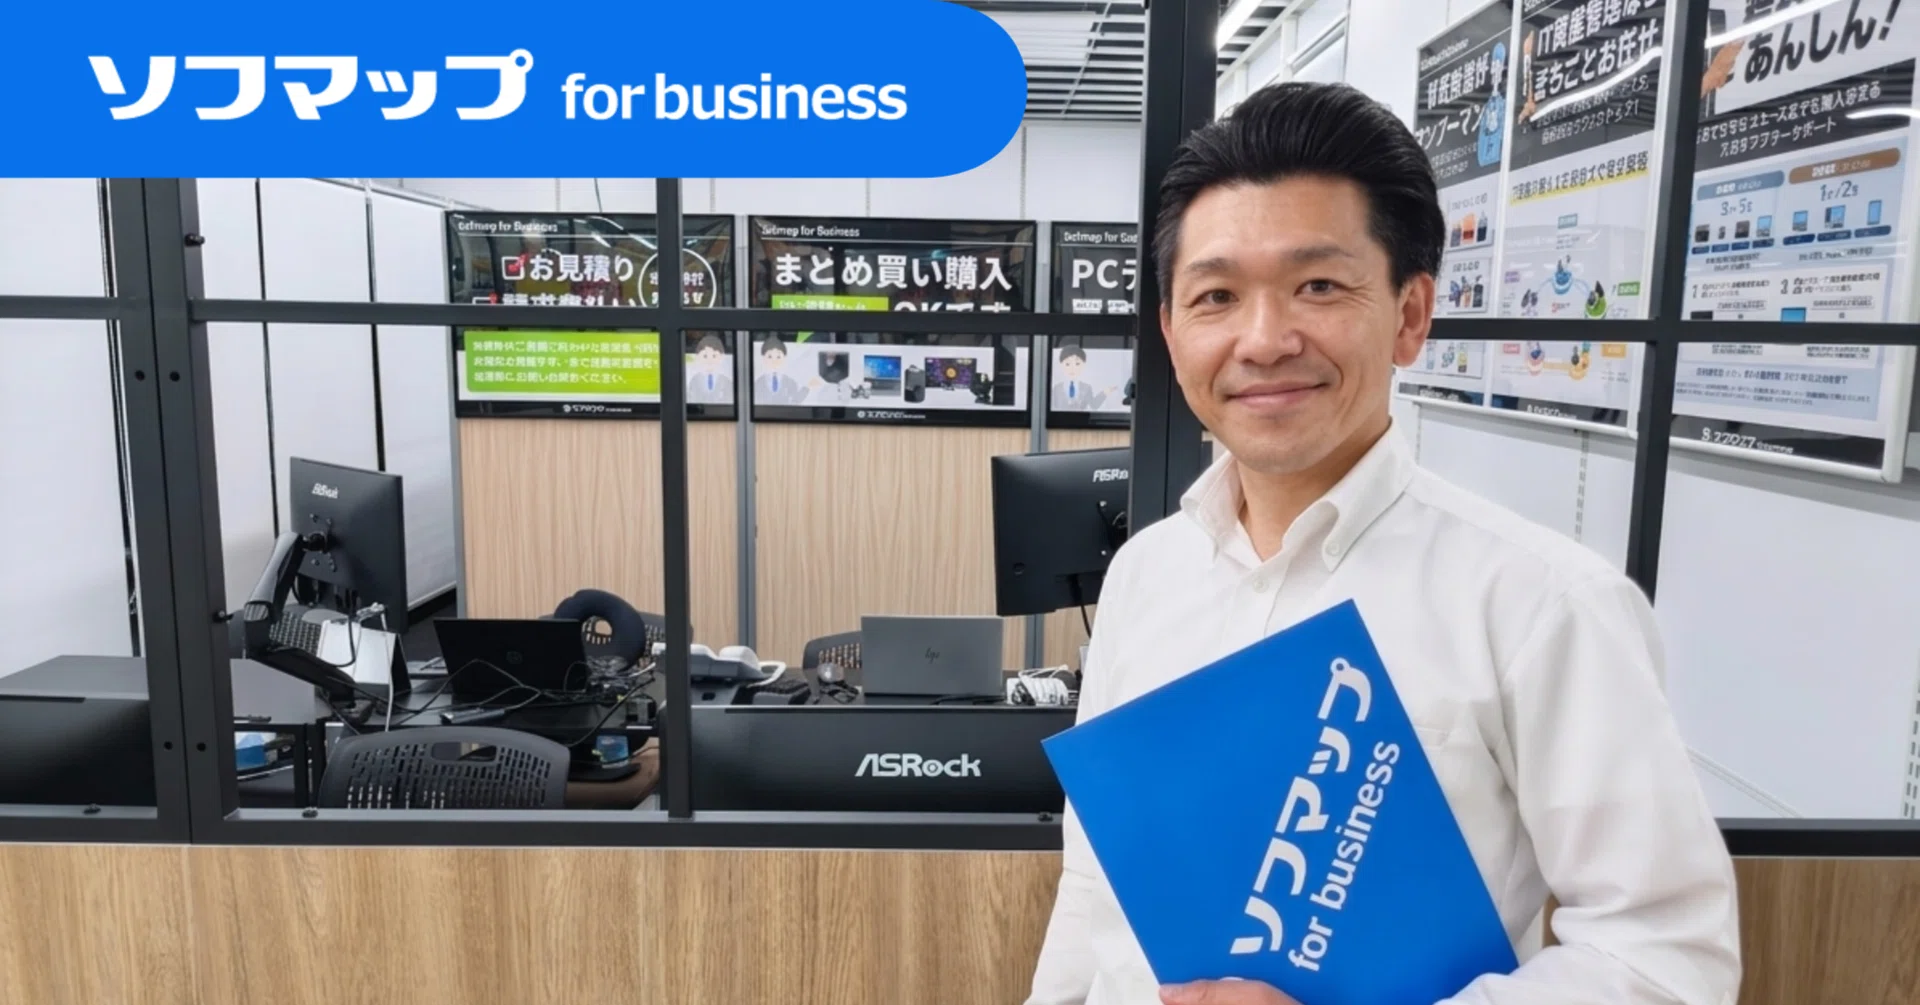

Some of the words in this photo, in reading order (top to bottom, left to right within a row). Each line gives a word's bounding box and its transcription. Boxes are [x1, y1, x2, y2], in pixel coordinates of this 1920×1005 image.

[530, 254, 634, 282] お見積り
[775, 253, 1013, 290] まとめ買い購入
[855, 753, 981, 777] ASRock
[1230, 657, 1372, 955] ソフマップ
[1310, 740, 1401, 910] business
[1288, 916, 1333, 972] for
